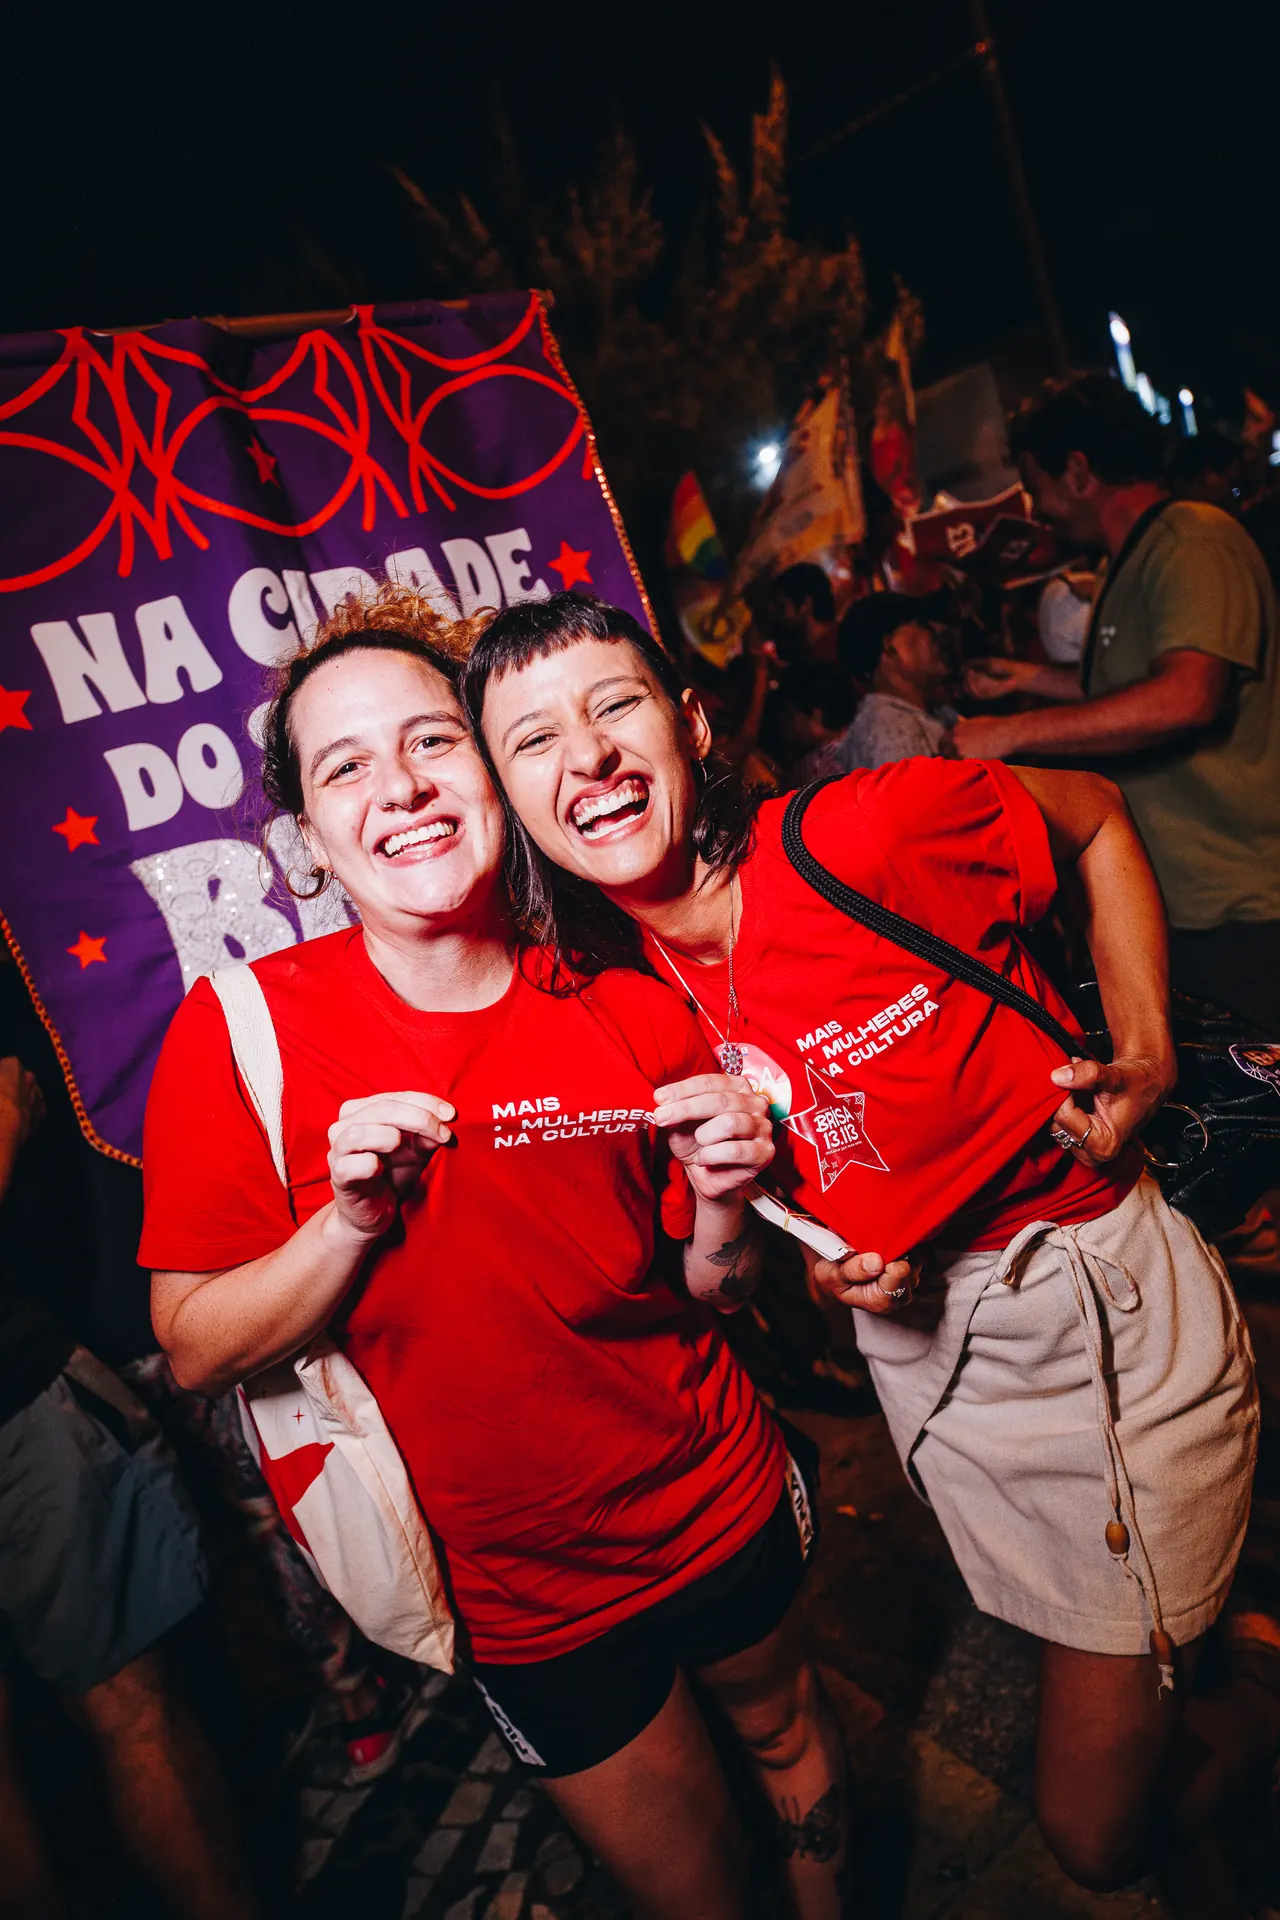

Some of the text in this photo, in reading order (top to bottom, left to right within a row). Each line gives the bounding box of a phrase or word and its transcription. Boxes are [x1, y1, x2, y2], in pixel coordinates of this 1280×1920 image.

[30, 595, 223, 725] NA
[103, 722, 244, 832] DO
[796, 1020, 843, 1052] MAIS
[822, 983, 929, 1060] MULHERES
[847, 1000, 939, 1066] CULTURA
[491, 1096, 561, 1120] MAIS
[522, 1109, 657, 1130] MULHERES
[494, 1122, 649, 1149] NA CULTUR
[823, 1123, 859, 1150] 13.113
